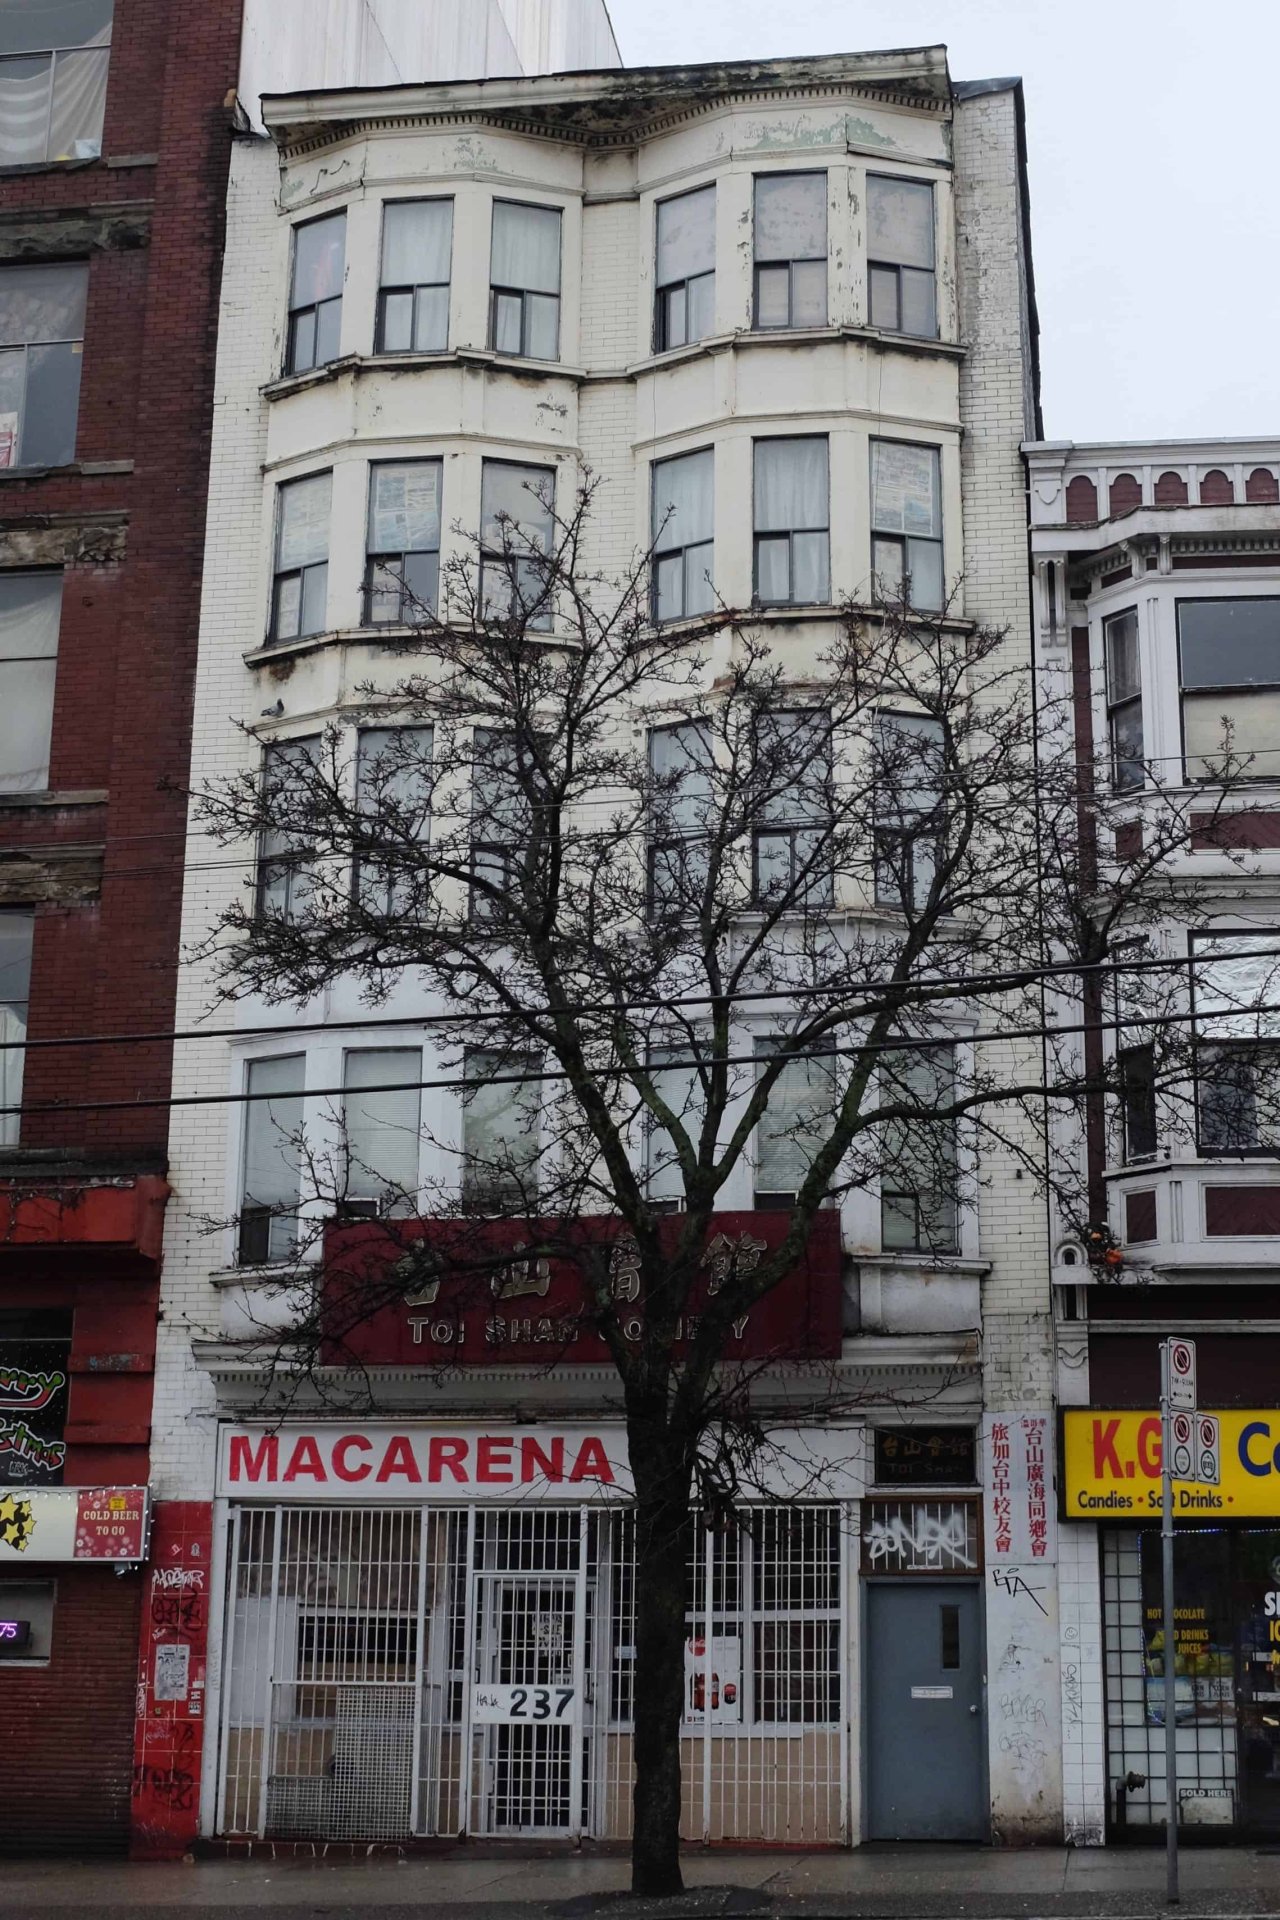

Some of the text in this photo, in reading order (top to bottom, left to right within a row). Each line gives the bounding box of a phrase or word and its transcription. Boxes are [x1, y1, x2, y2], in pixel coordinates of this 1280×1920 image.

[407, 1316, 465, 1344] TOI
[229, 1434, 616, 1483] MACARENA
[991, 1423, 1012, 1553] 旅加台中校友會
[1025, 1428, 1047, 1557] 台山廣海同鄉會
[1078, 1490, 1133, 1509] Candies
[1180, 1490, 1223, 1509] Drinks
[83, 1510, 140, 1521] COLD BEER
[96, 1526, 126, 1536] TO GO
[1147, 1608, 1162, 1619] HOT
[1181, 1628, 1209, 1640] DRINKS
[1178, 1642, 1201, 1654] JUICES
[510, 1688, 575, 1720] 237
[1180, 1789, 1233, 1798] SOLD HERE
